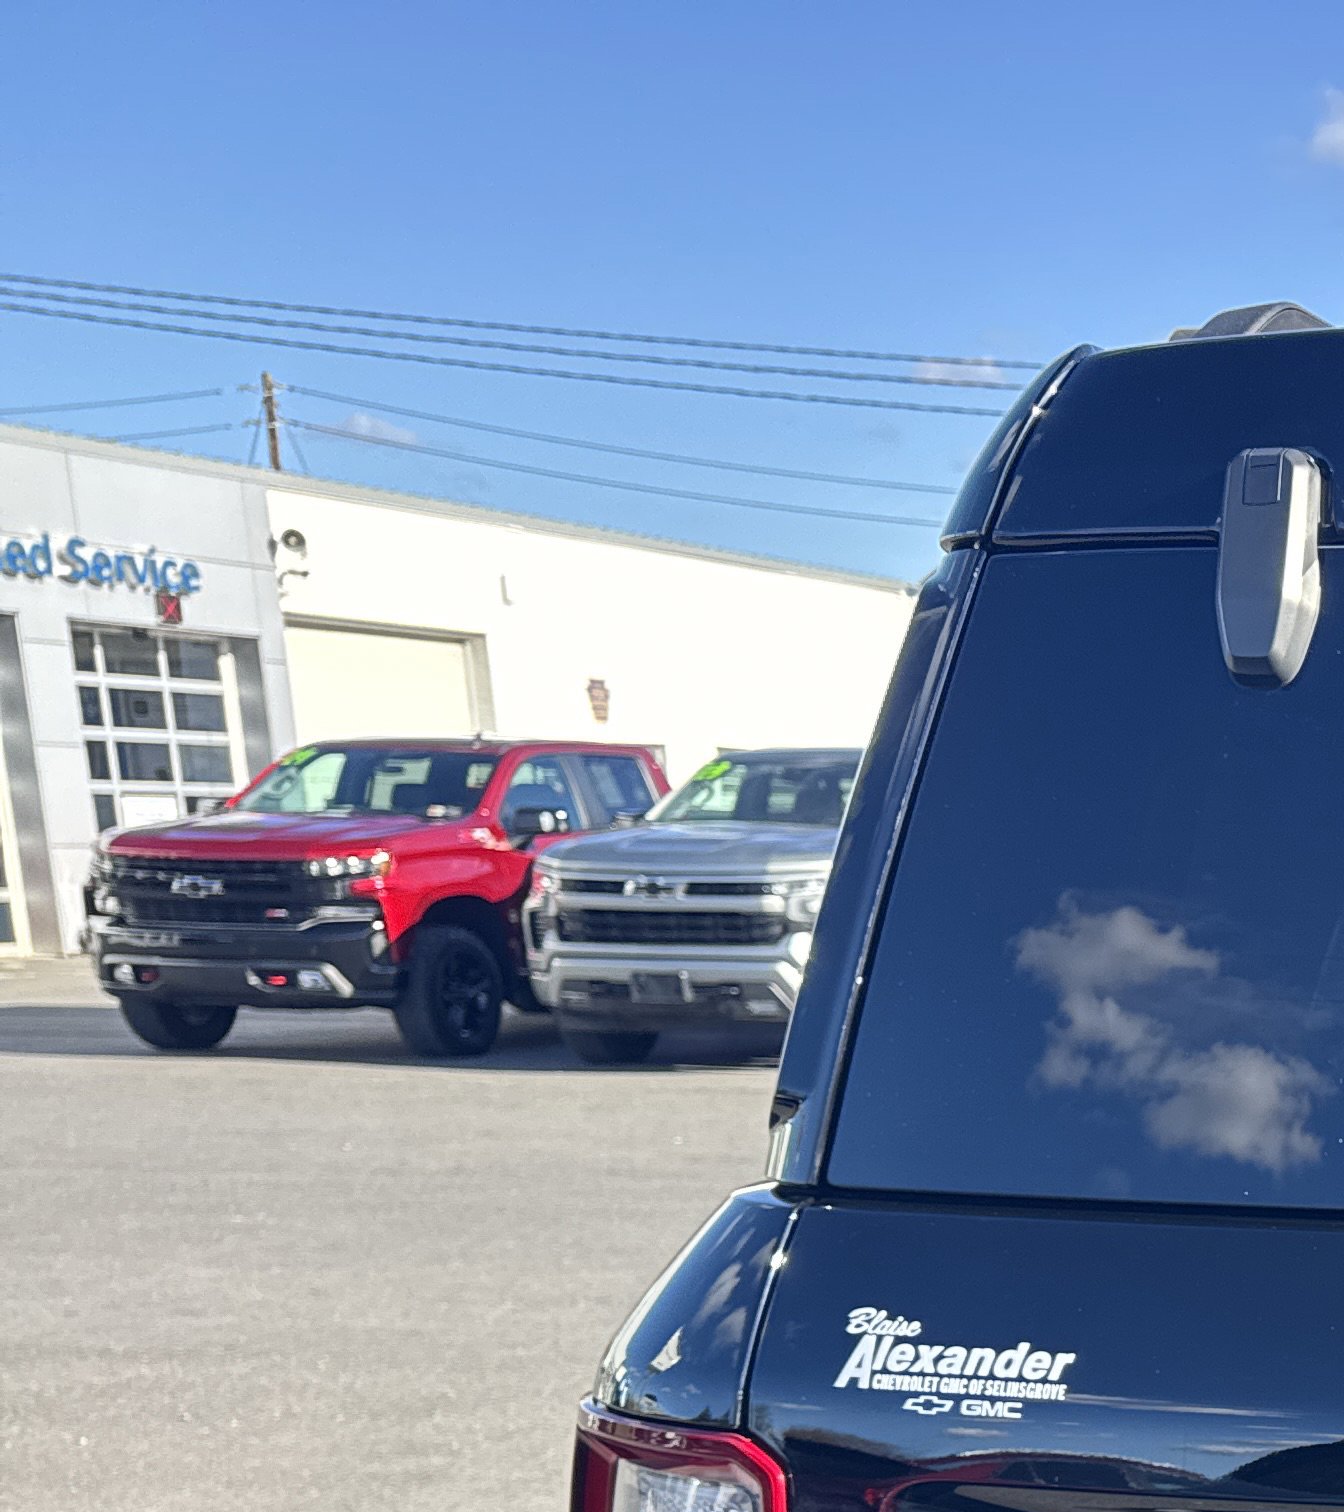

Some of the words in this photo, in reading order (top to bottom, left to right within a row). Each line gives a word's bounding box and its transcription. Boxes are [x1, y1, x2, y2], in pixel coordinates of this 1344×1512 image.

[0, 532, 52, 577] ed
[65, 537, 201, 592] Service
[845, 1306, 922, 1337] Blaise
[833, 1334, 1077, 1389] Alexander
[871, 1374, 940, 1392] CHEVROLET
[939, 1377, 968, 1395] GMC
[968, 1380, 987, 1396] OF
[984, 1380, 1068, 1401] SELINSGROVE
[960, 1399, 1023, 1419] GMC
